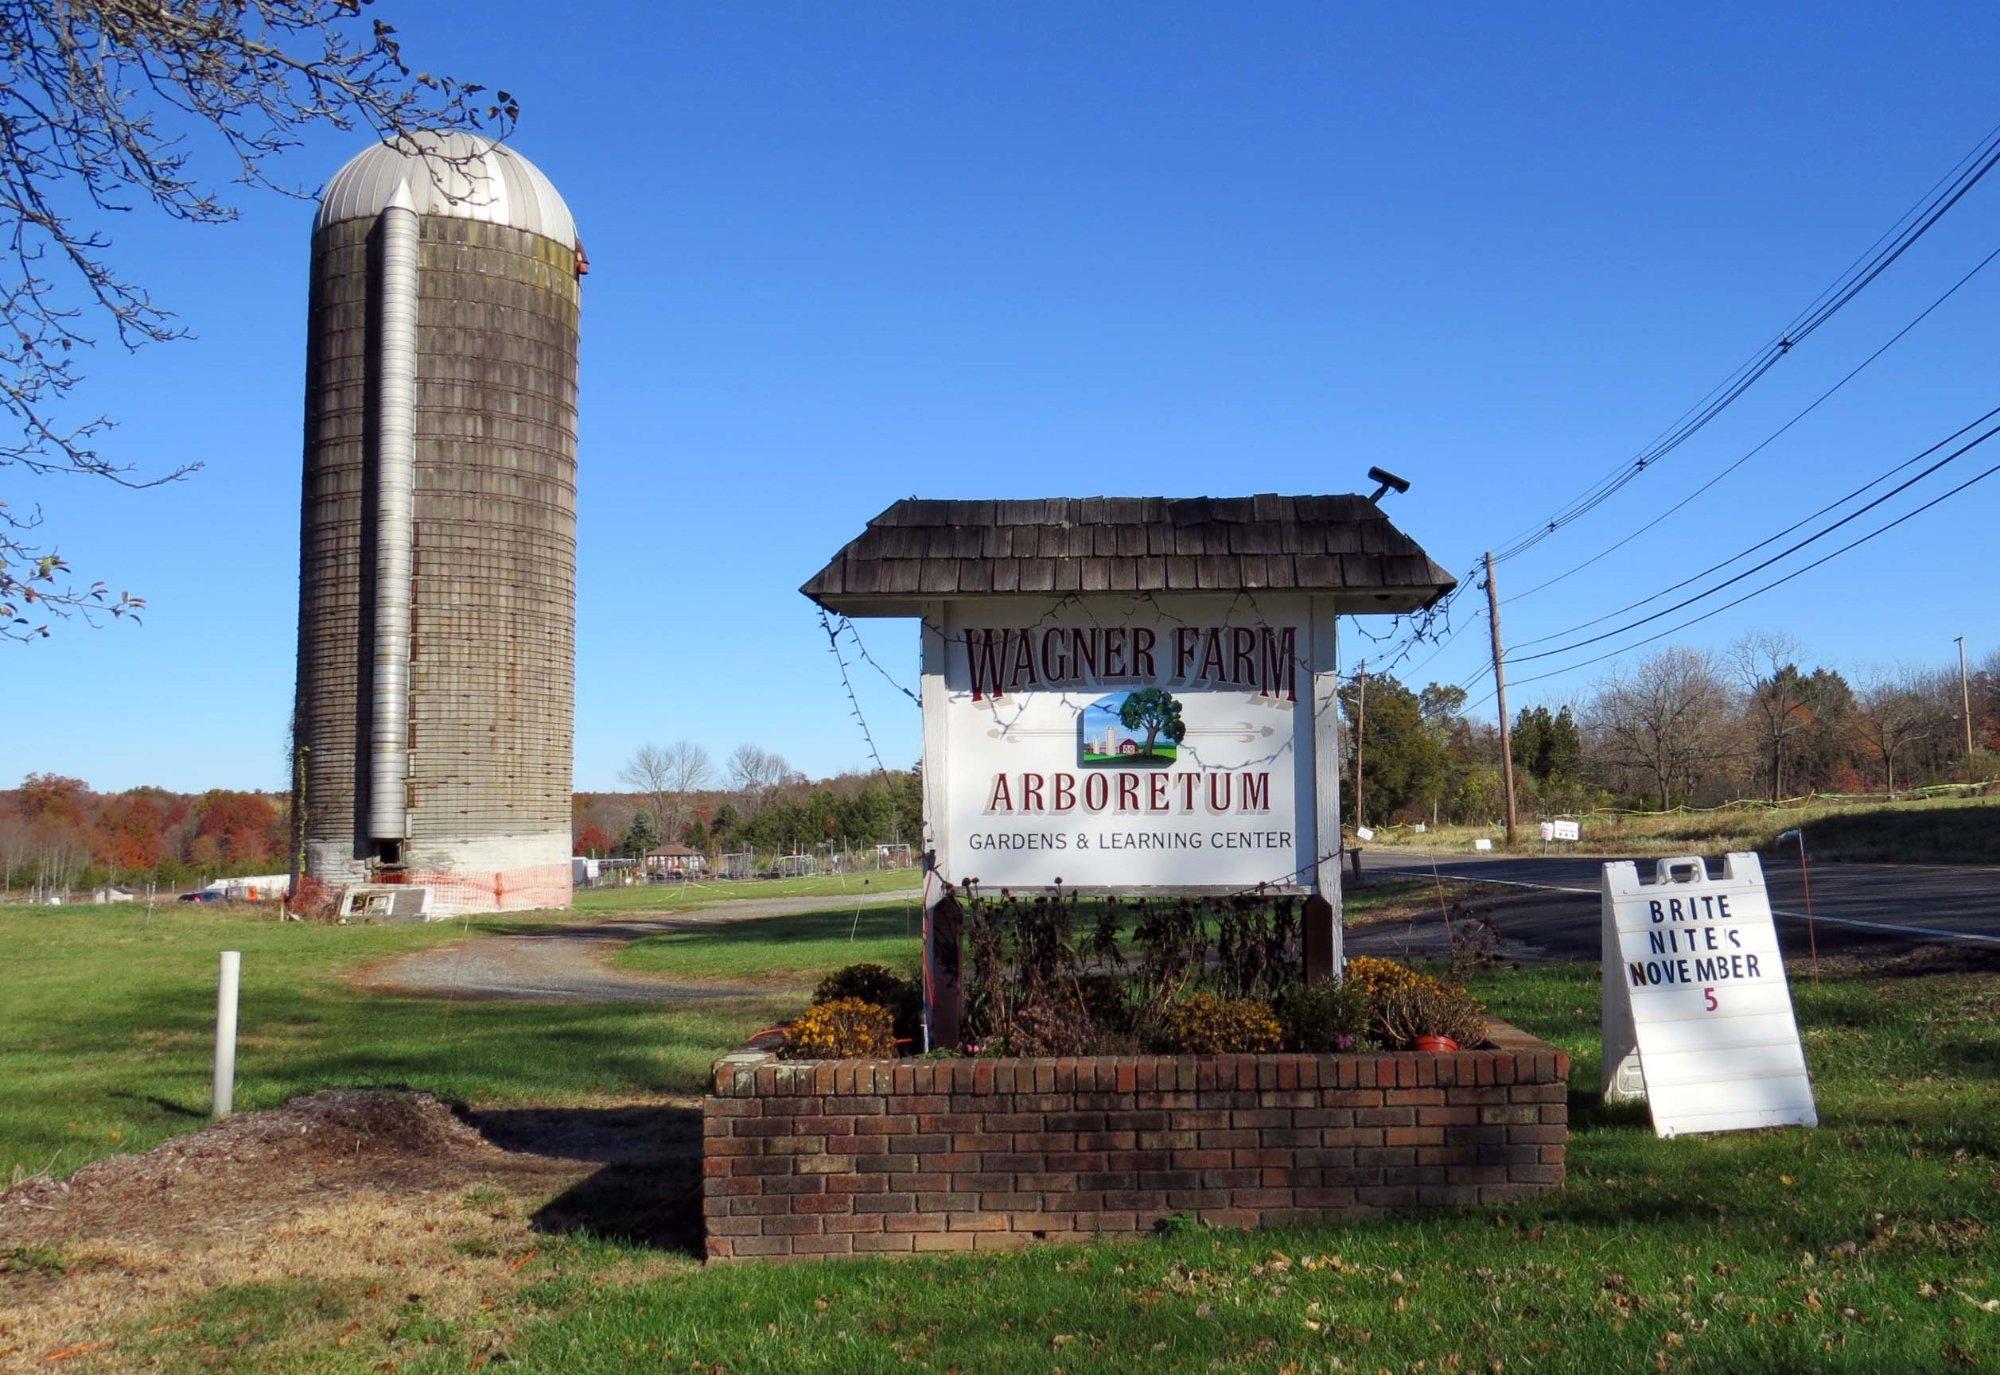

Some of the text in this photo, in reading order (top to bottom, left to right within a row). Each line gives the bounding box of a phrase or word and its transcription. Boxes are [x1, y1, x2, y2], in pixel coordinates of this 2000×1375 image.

[964, 627, 1297, 701] WAGNER FARM
[990, 772, 1271, 811] ARBORETUM
[969, 831, 1292, 850] GARDENS & LEARNING CENTER
[1649, 895, 1732, 924] BRITE
[1629, 954, 1762, 987] NOVEMBER
[1703, 987, 1719, 1012] 5
